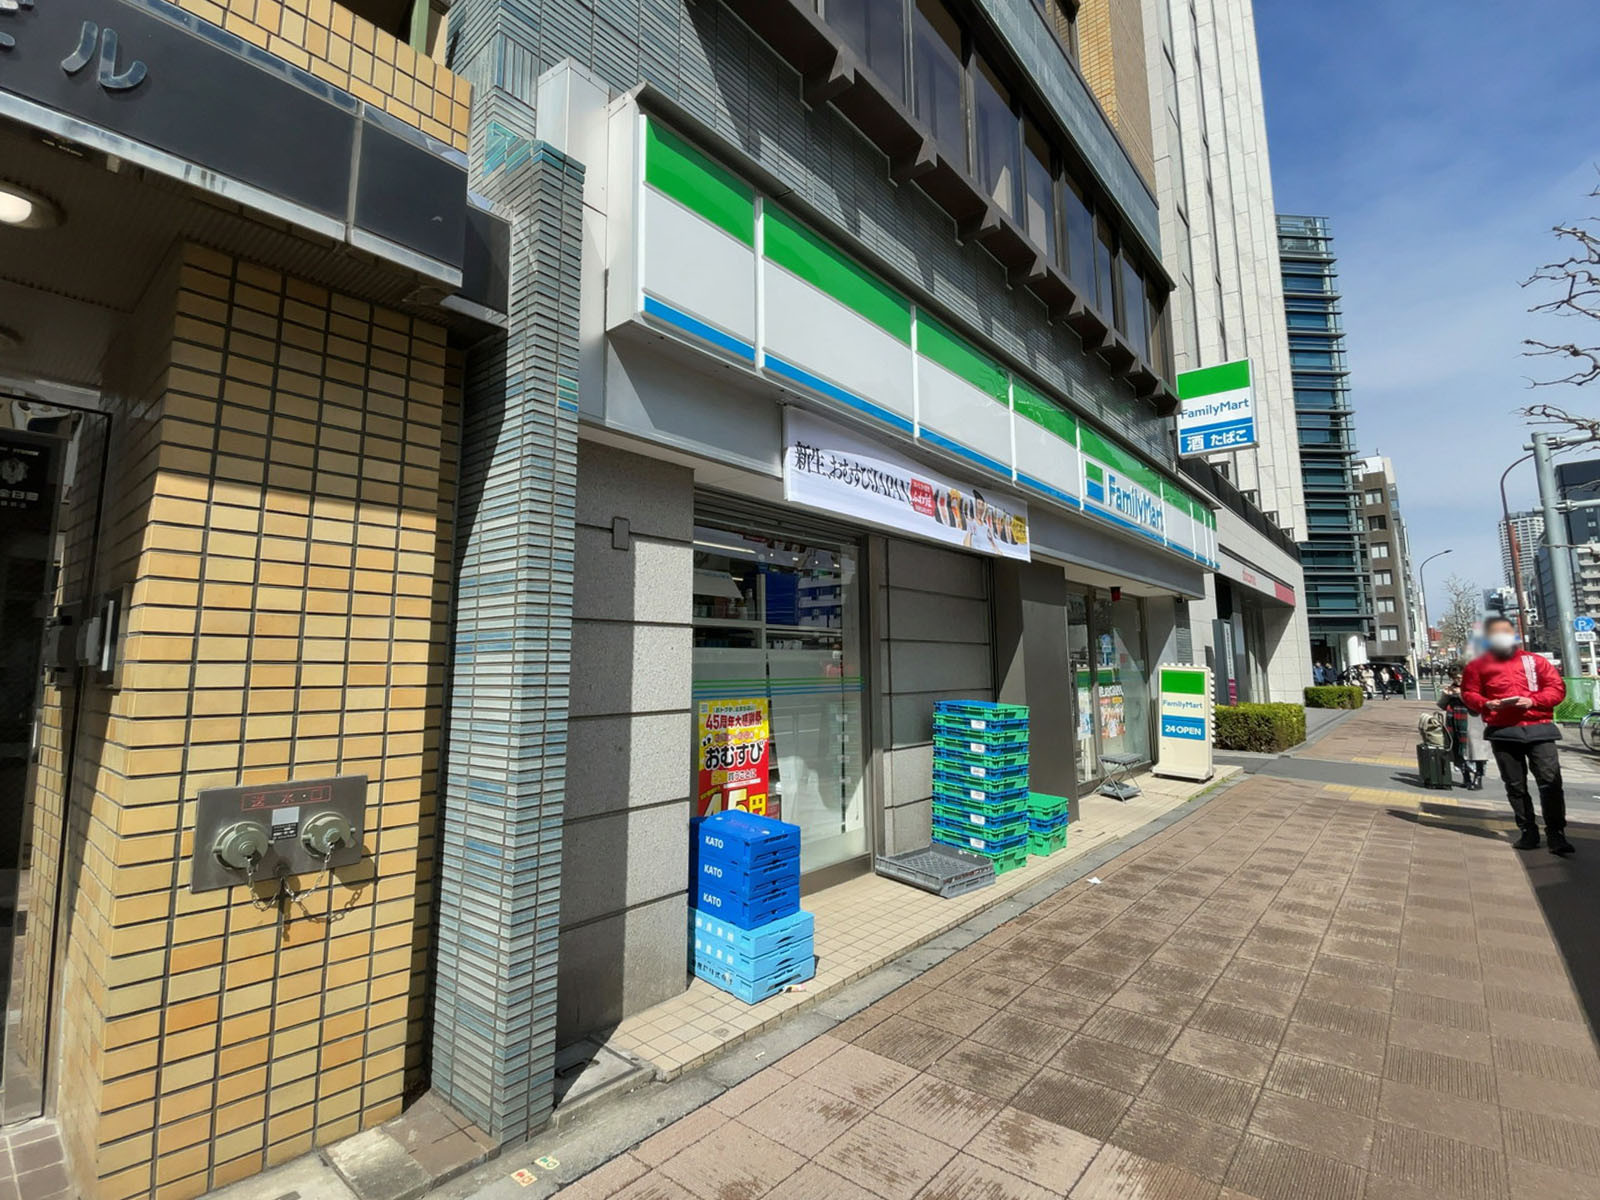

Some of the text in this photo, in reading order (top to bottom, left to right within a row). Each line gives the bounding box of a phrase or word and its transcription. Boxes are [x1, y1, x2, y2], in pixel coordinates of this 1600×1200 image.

[1179, 398, 1249, 419] FamilyMart
[1187, 429, 1248, 451] 酒 たばこ
[1162, 699, 1203, 709] FamilyMart
[706, 742, 763, 769] おむすび
[705, 835, 724, 849] KATO
[703, 864, 723, 878] KATO
[702, 892, 722, 908] KATO
